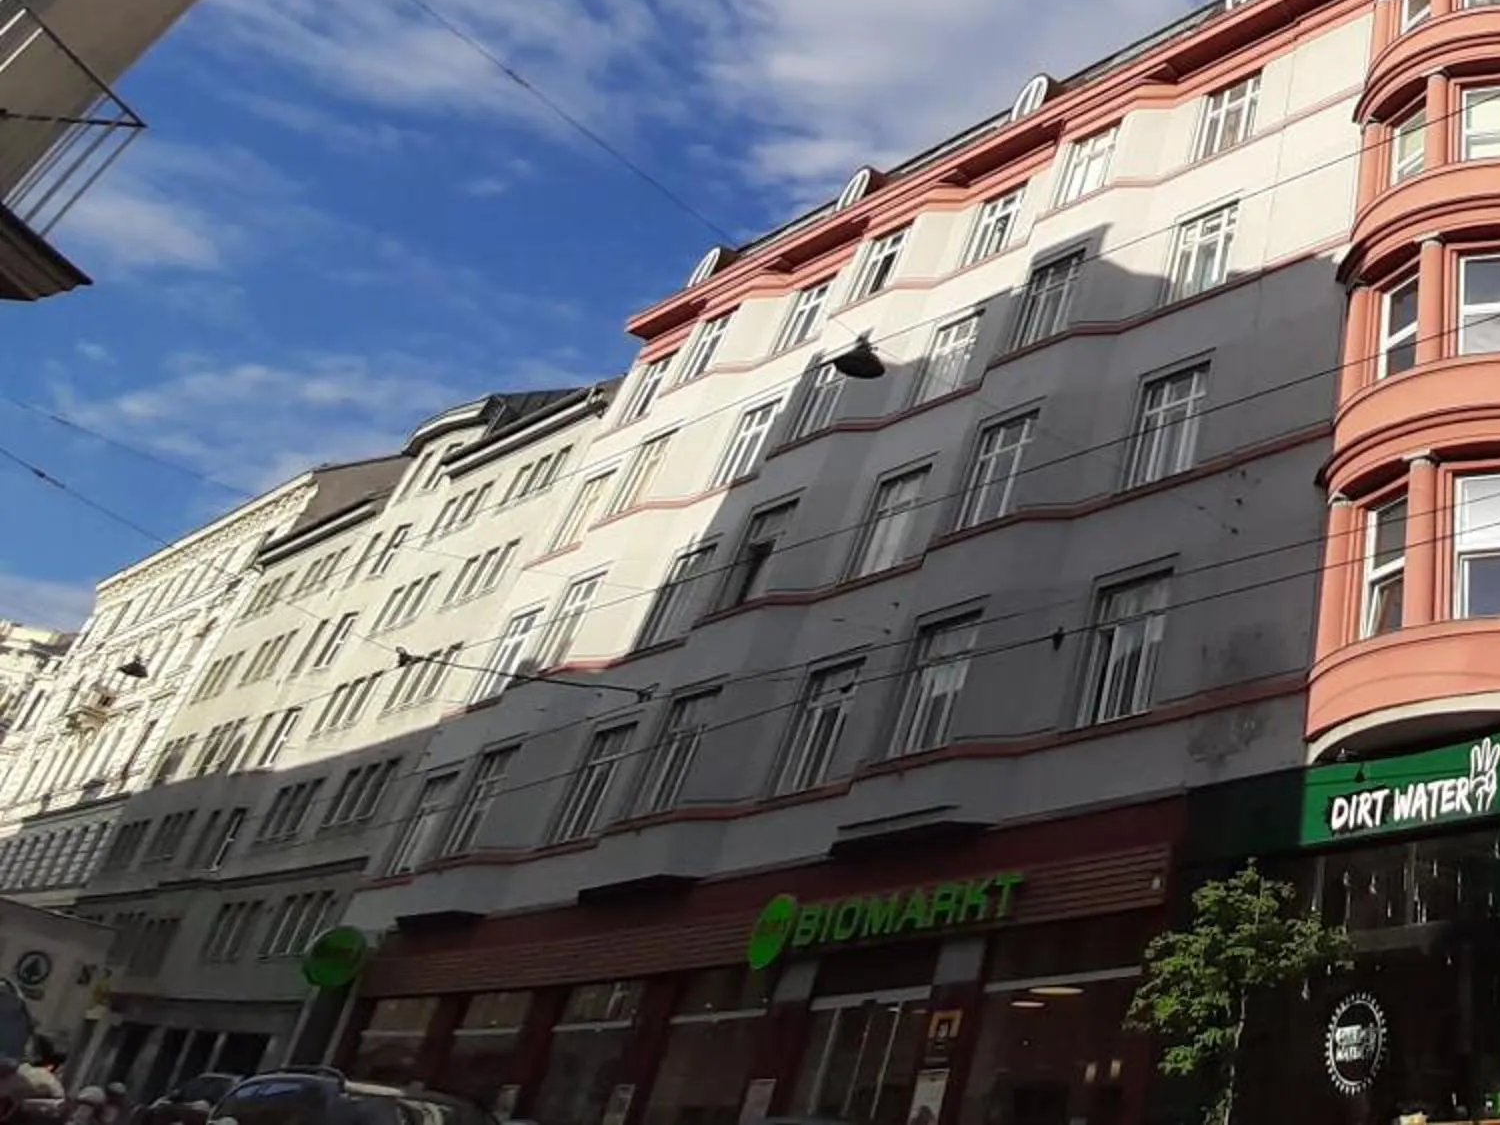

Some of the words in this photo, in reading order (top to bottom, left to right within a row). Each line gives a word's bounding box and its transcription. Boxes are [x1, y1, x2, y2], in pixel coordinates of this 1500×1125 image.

[1331, 786, 1391, 831] DIRT
[1393, 777, 1473, 822] WATER
[792, 872, 1026, 948] BIOMARKT
